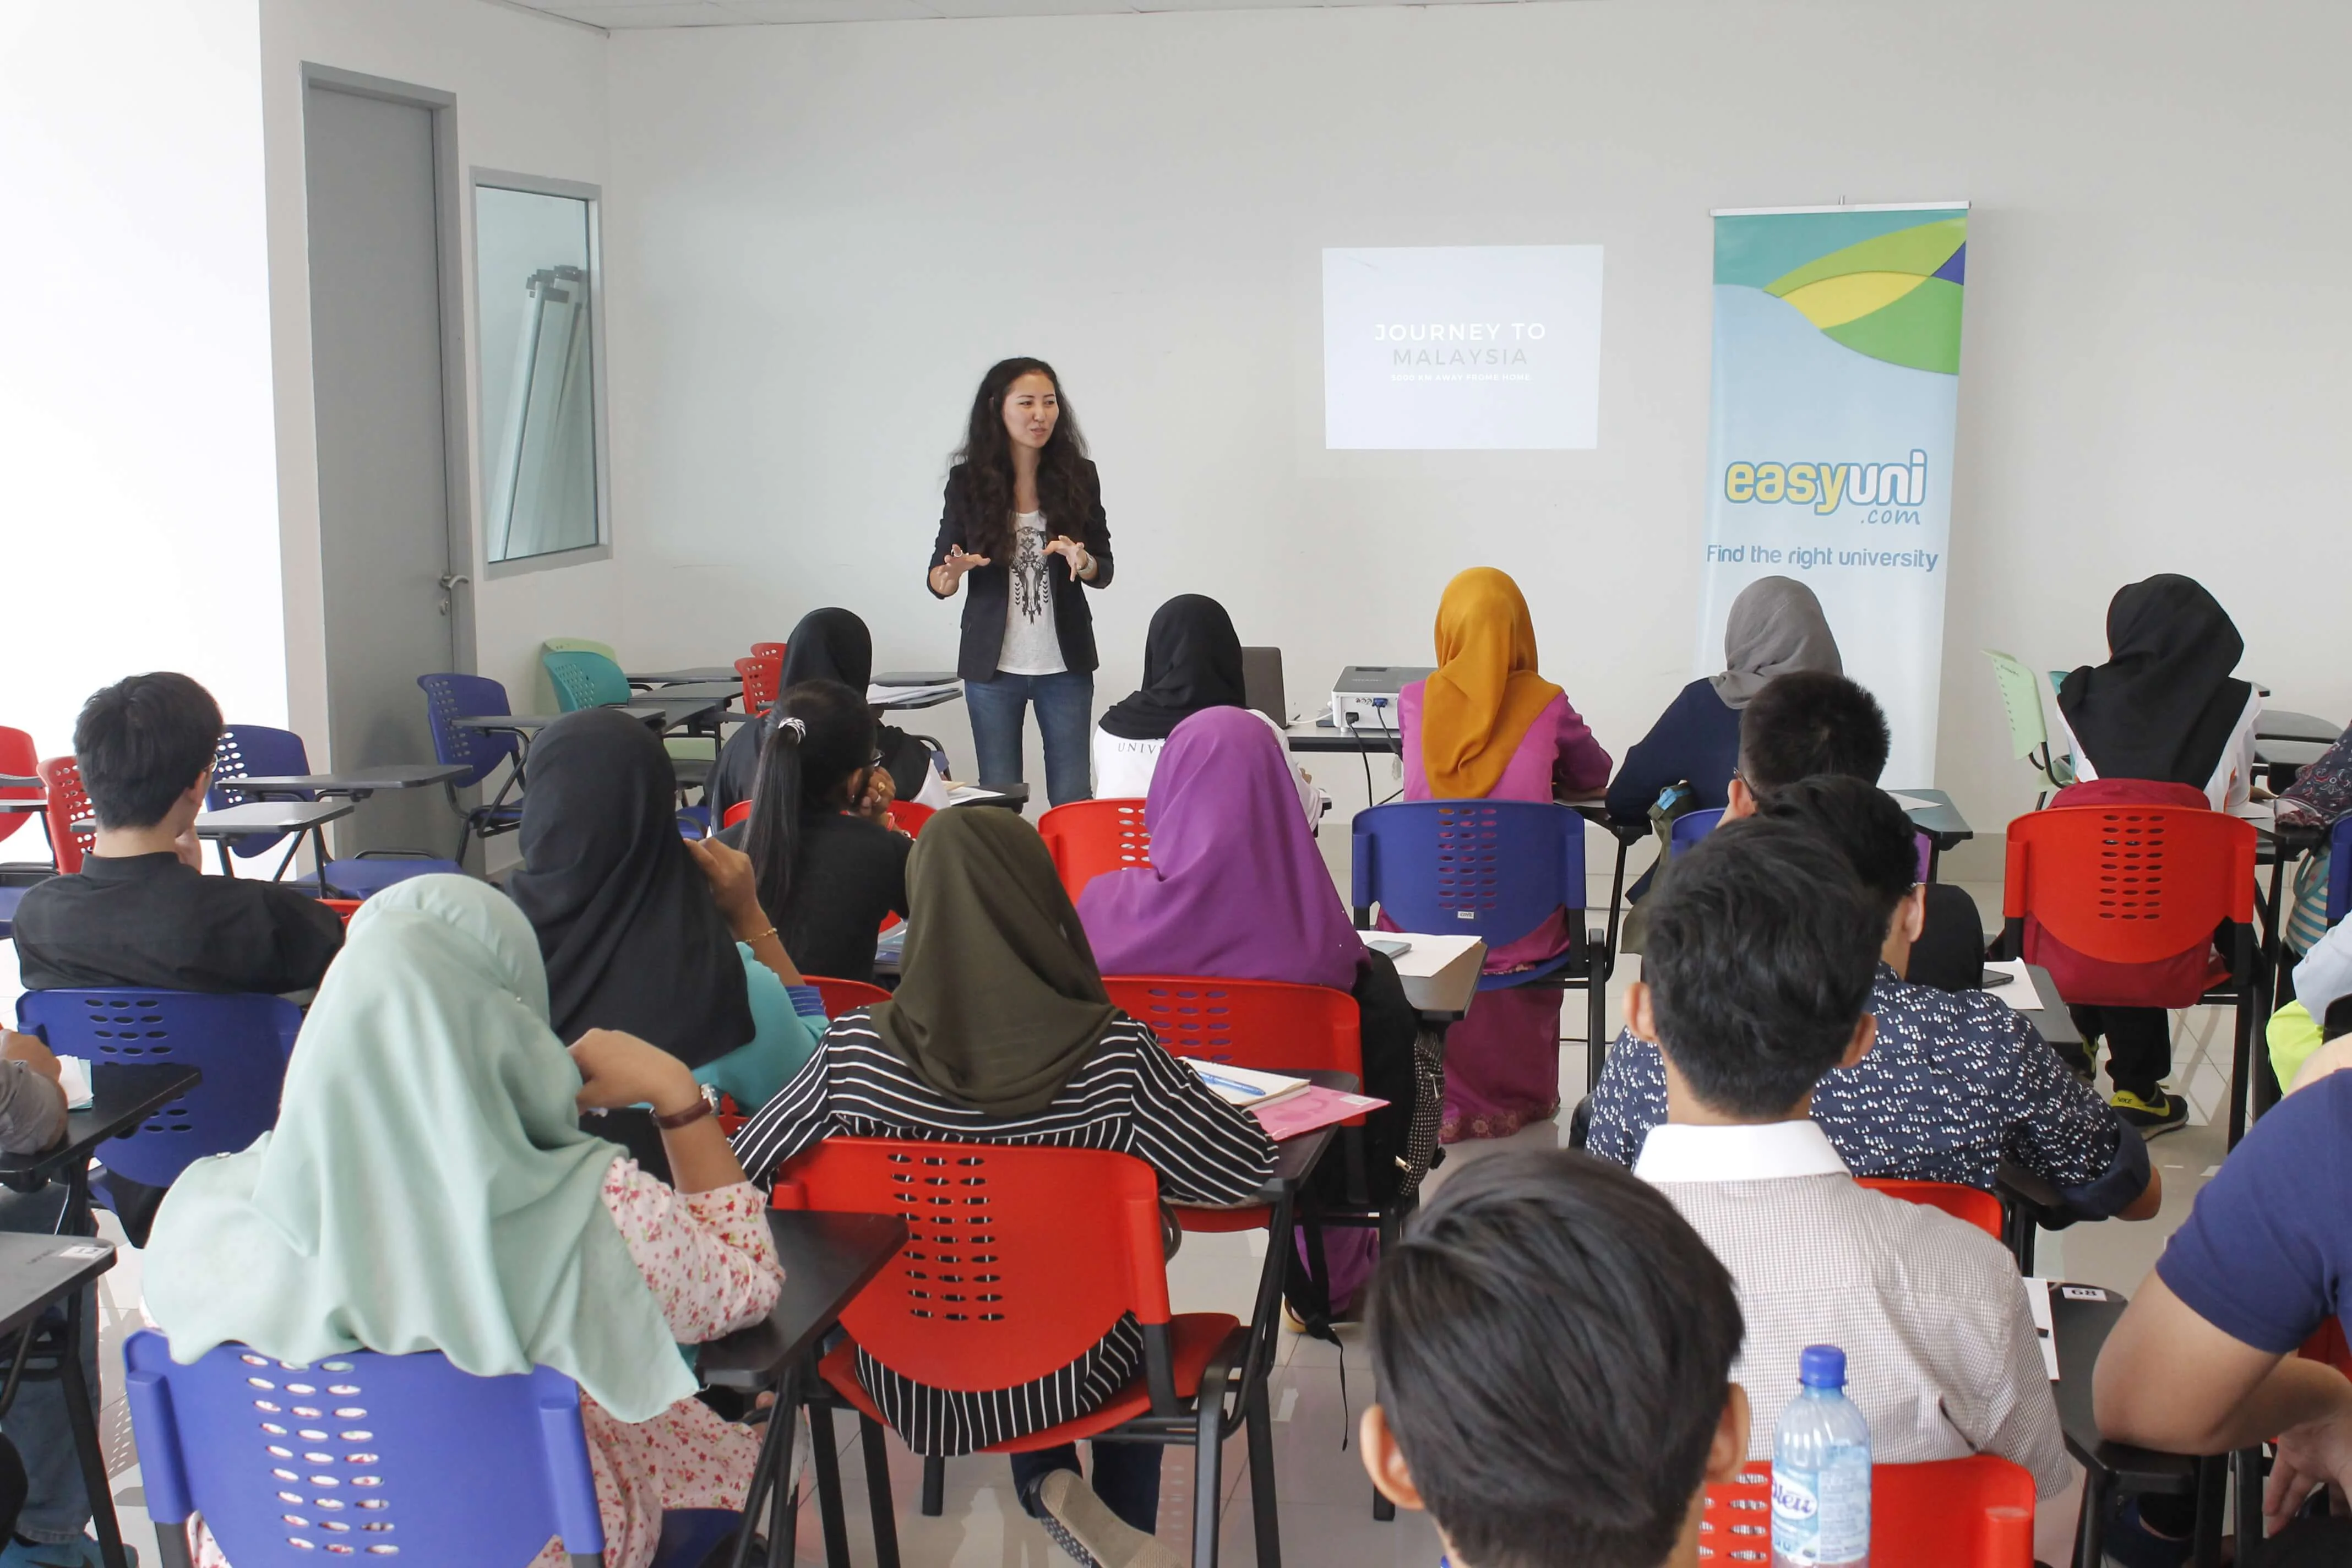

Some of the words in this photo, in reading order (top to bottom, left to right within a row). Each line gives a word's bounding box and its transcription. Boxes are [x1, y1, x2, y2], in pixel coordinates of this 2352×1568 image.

[1374, 323, 1501, 341] JOURNEY
[1511, 323, 1545, 340] TO
[1393, 349, 1527, 366] MALAYSIA
[1724, 449, 1928, 516] easyuni
[1860, 509, 1920, 525] .com
[1707, 545, 1744, 563] Find
[1750, 546, 1782, 564] the
[1788, 547, 1832, 570] right
[1839, 549, 1939, 572] university
[1118, 742, 1163, 755] UNIV
